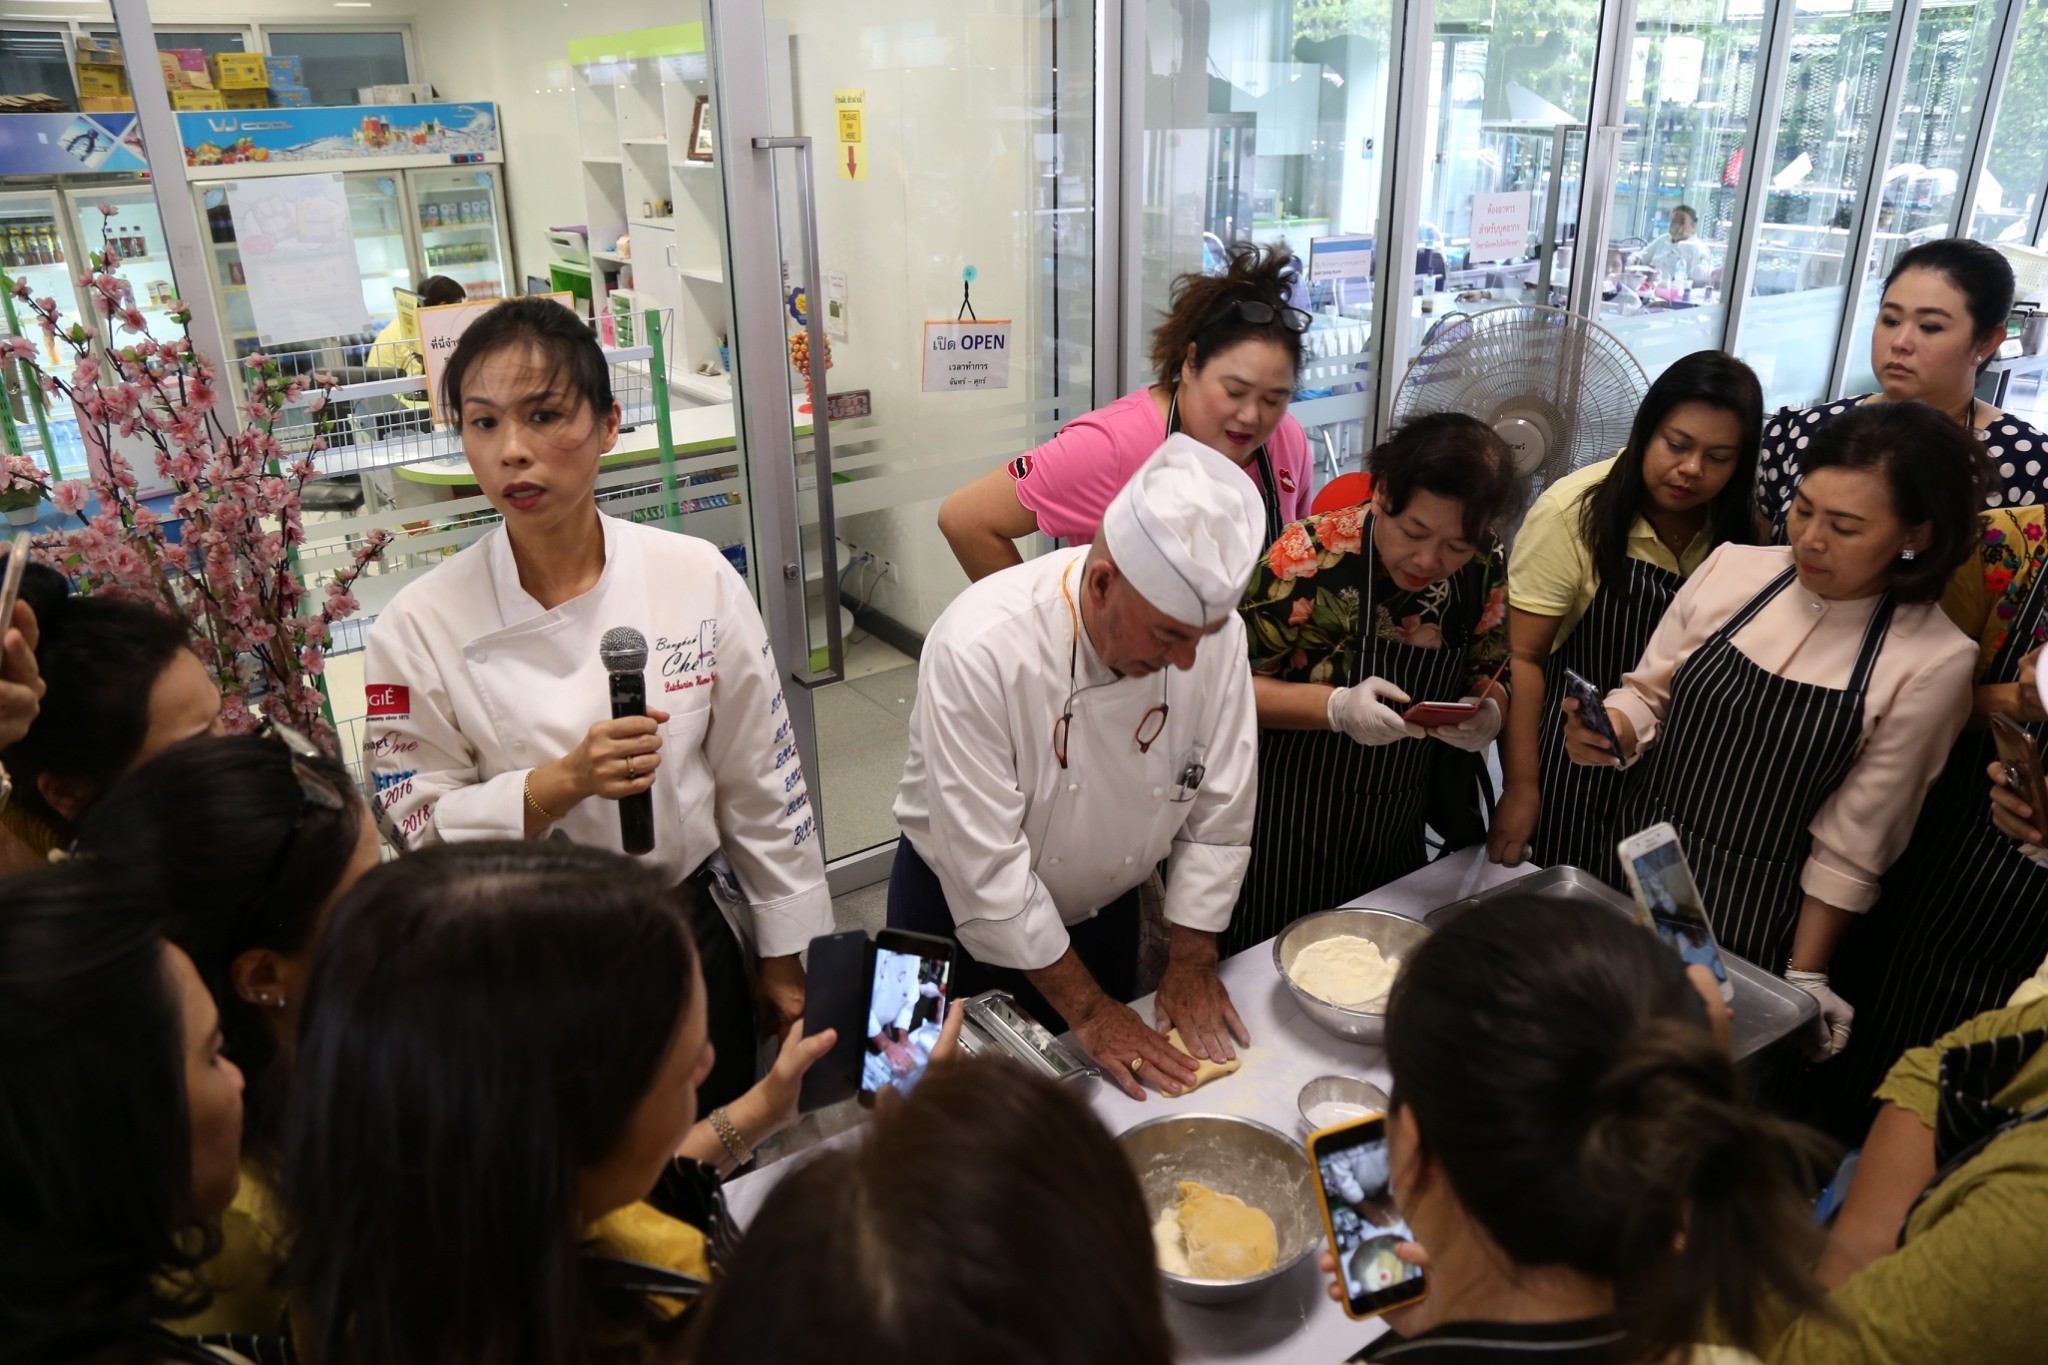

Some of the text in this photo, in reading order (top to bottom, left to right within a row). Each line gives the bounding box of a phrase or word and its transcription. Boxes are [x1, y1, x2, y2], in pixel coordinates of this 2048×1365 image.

[1487, 203, 1516, 215] ห้องอาหาร
[430, 335, 459, 350] ที่นี่จำ
[933, 334, 1005, 350] เปิด OPEN
[948, 361, 988, 371] เวลาทำการ
[949, 377, 966, 385] จันทร์
[973, 376, 987, 387] ศุกร์
[368, 687, 395, 706] GIÉ
[385, 779, 412, 809] 2016
[402, 804, 430, 838] 2018
